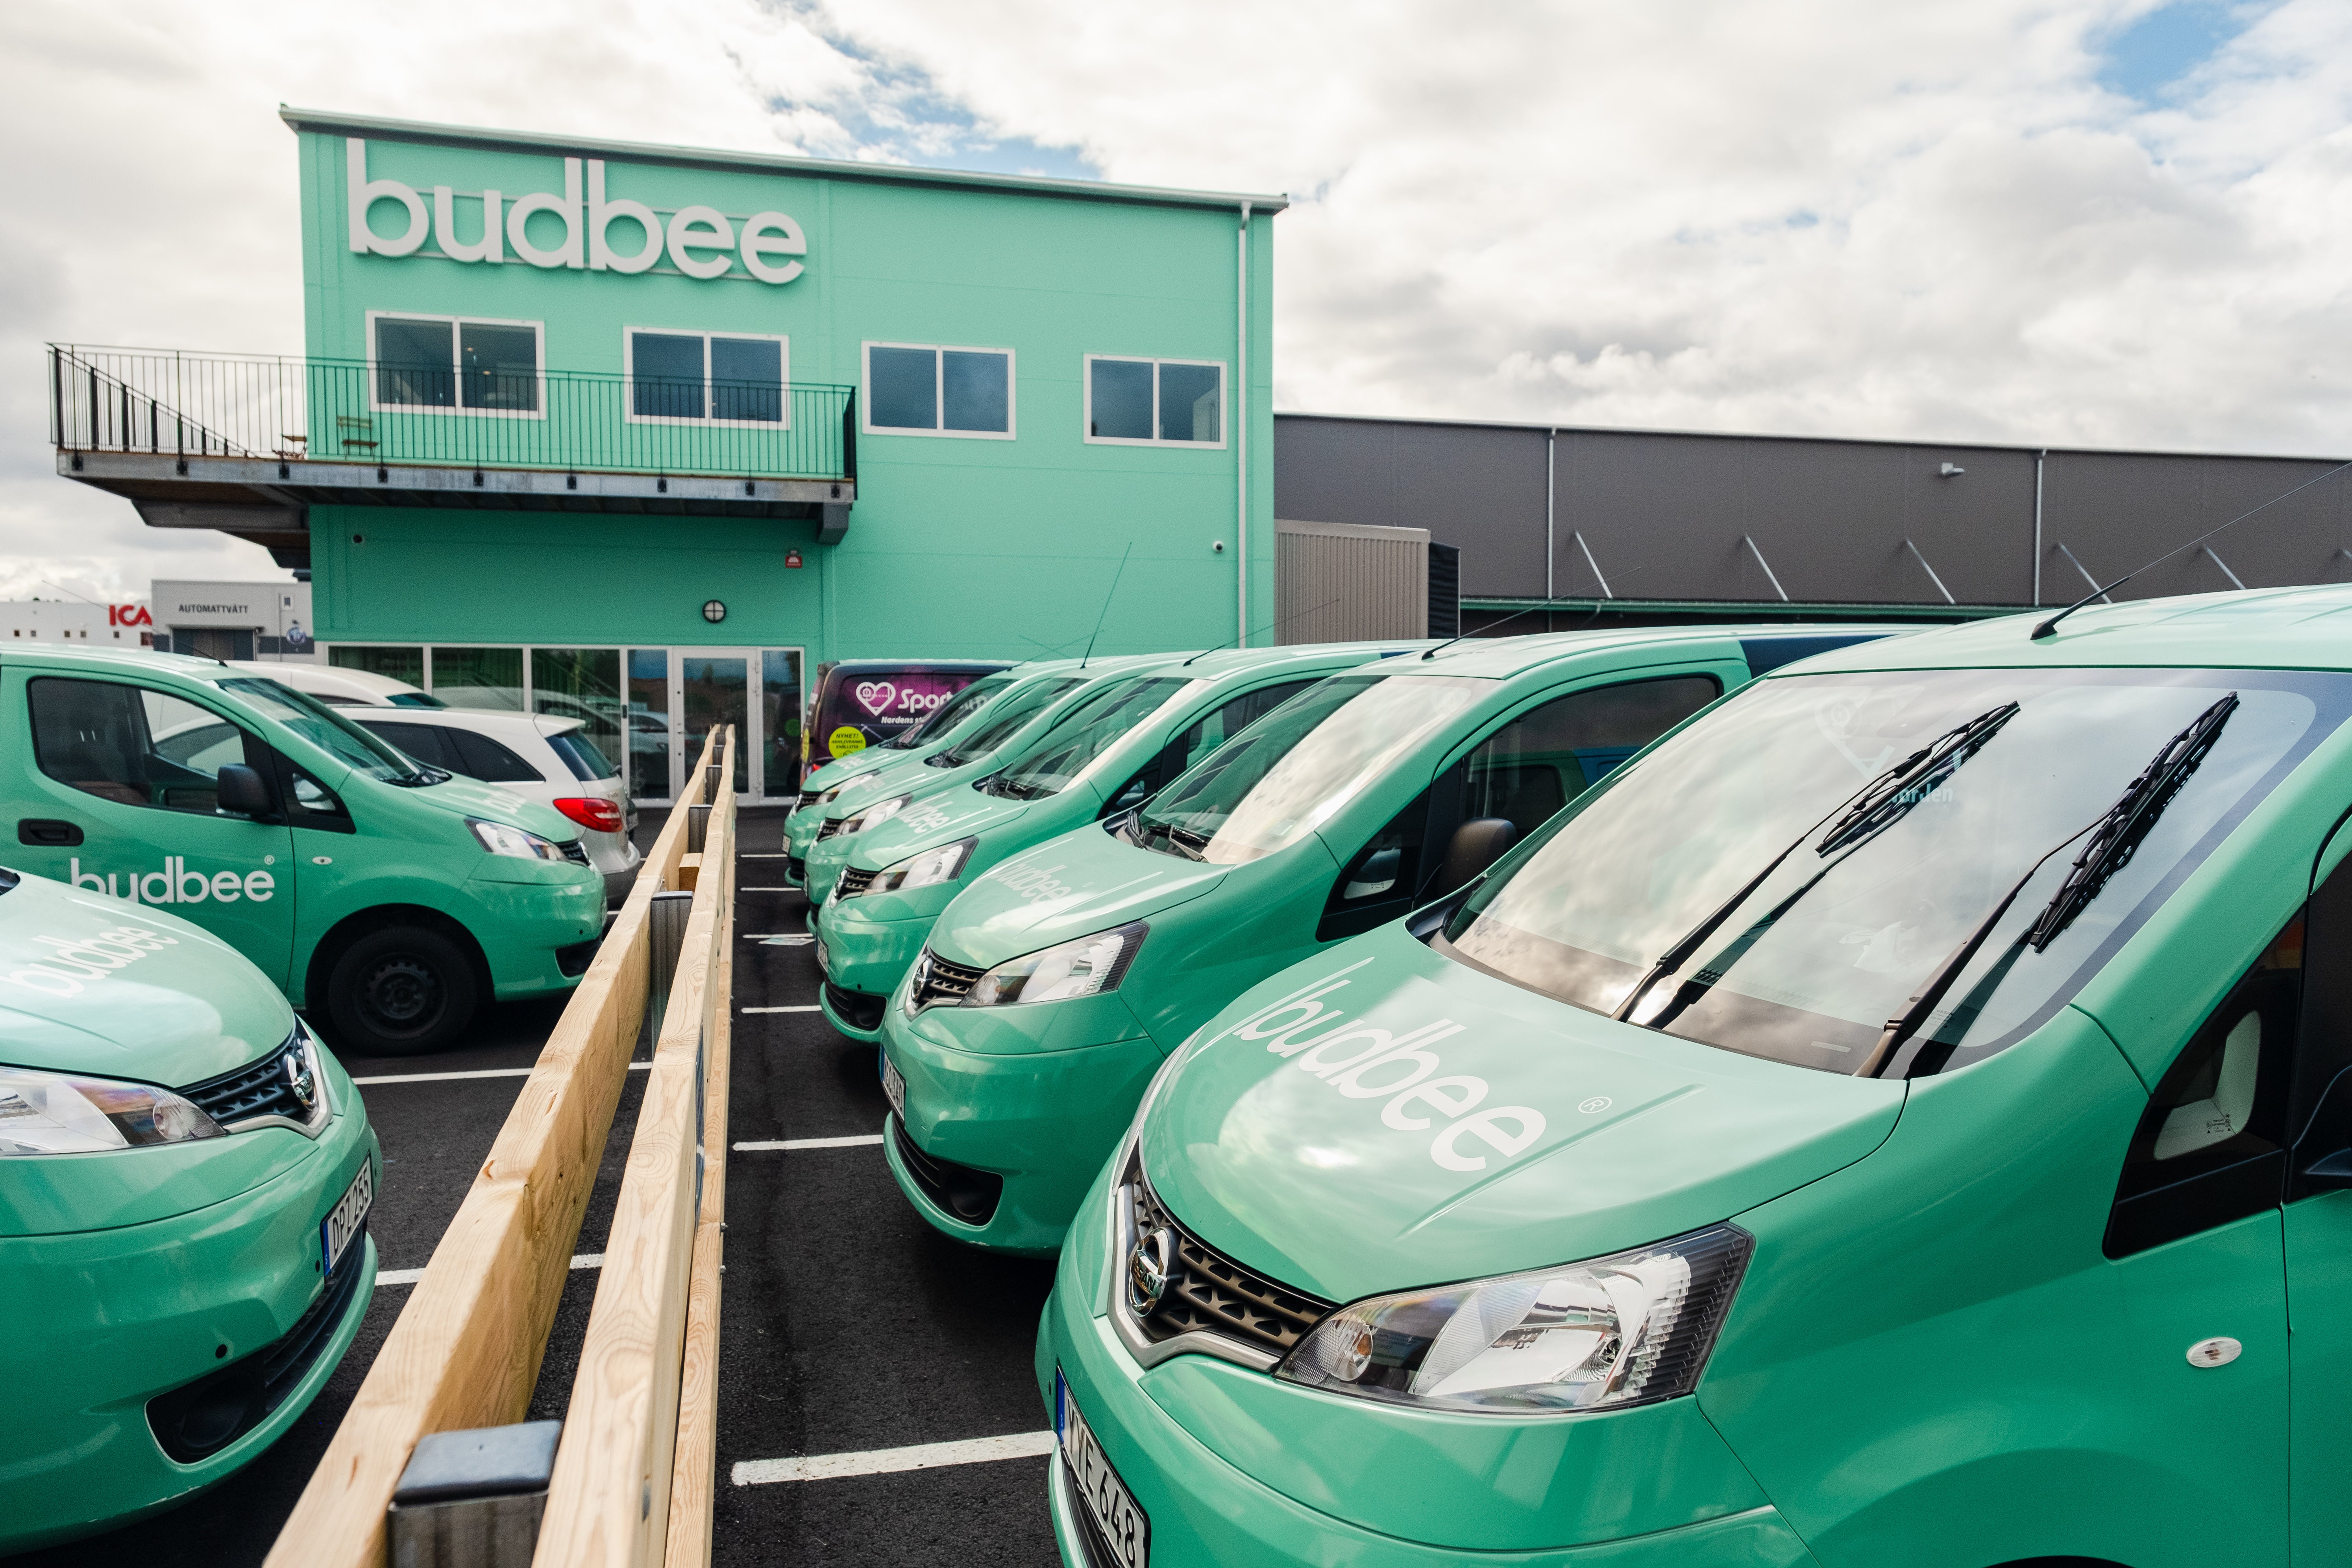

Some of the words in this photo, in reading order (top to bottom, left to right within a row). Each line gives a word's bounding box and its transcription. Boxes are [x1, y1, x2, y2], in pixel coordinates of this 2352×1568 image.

[346, 137, 807, 284] budbee
[109, 605, 152, 627] ICA
[881, 716, 913, 724] Nordens
[70, 856, 275, 904] budbee
[0, 926, 179, 998] budbee
[1233, 979, 1546, 1172] budbee
[332, 1194, 352, 1256] DPZ
[353, 1166, 369, 1222] 255
[1067, 1396, 1094, 1498] YYE
[1099, 1468, 1136, 1568] 648
